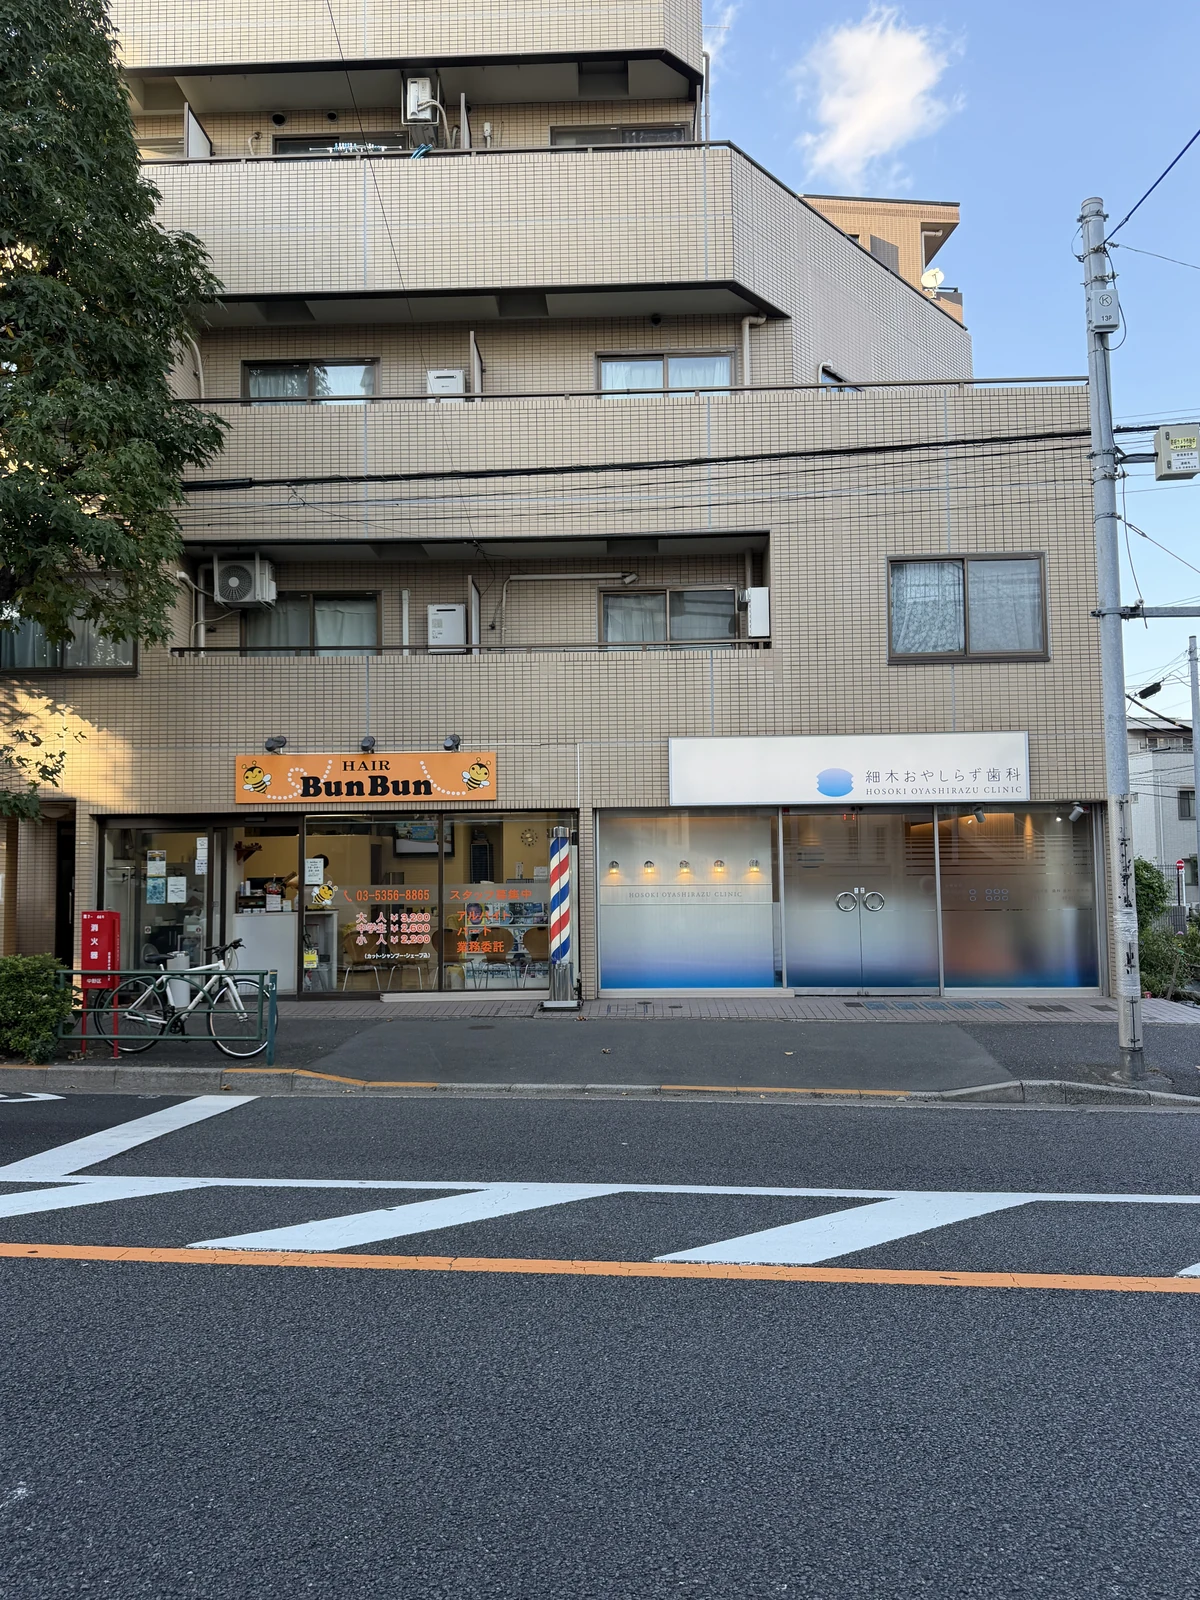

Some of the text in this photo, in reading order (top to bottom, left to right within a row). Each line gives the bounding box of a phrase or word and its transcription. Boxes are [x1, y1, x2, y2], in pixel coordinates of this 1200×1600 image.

[342, 760, 391, 772] HAIR
[865, 767, 1021, 783] 細木おやしらず歯科
[300, 775, 433, 798] BunBun
[866, 785, 1022, 796] HOSOKI OYASHIRAZU CLINIC
[356, 889, 430, 901] 03-5356-8865
[450, 889, 532, 900] スタッフ募集中
[457, 910, 510, 921] アルバイト
[356, 922, 387, 934] 中学生
[457, 941, 504, 953] 業務委託
